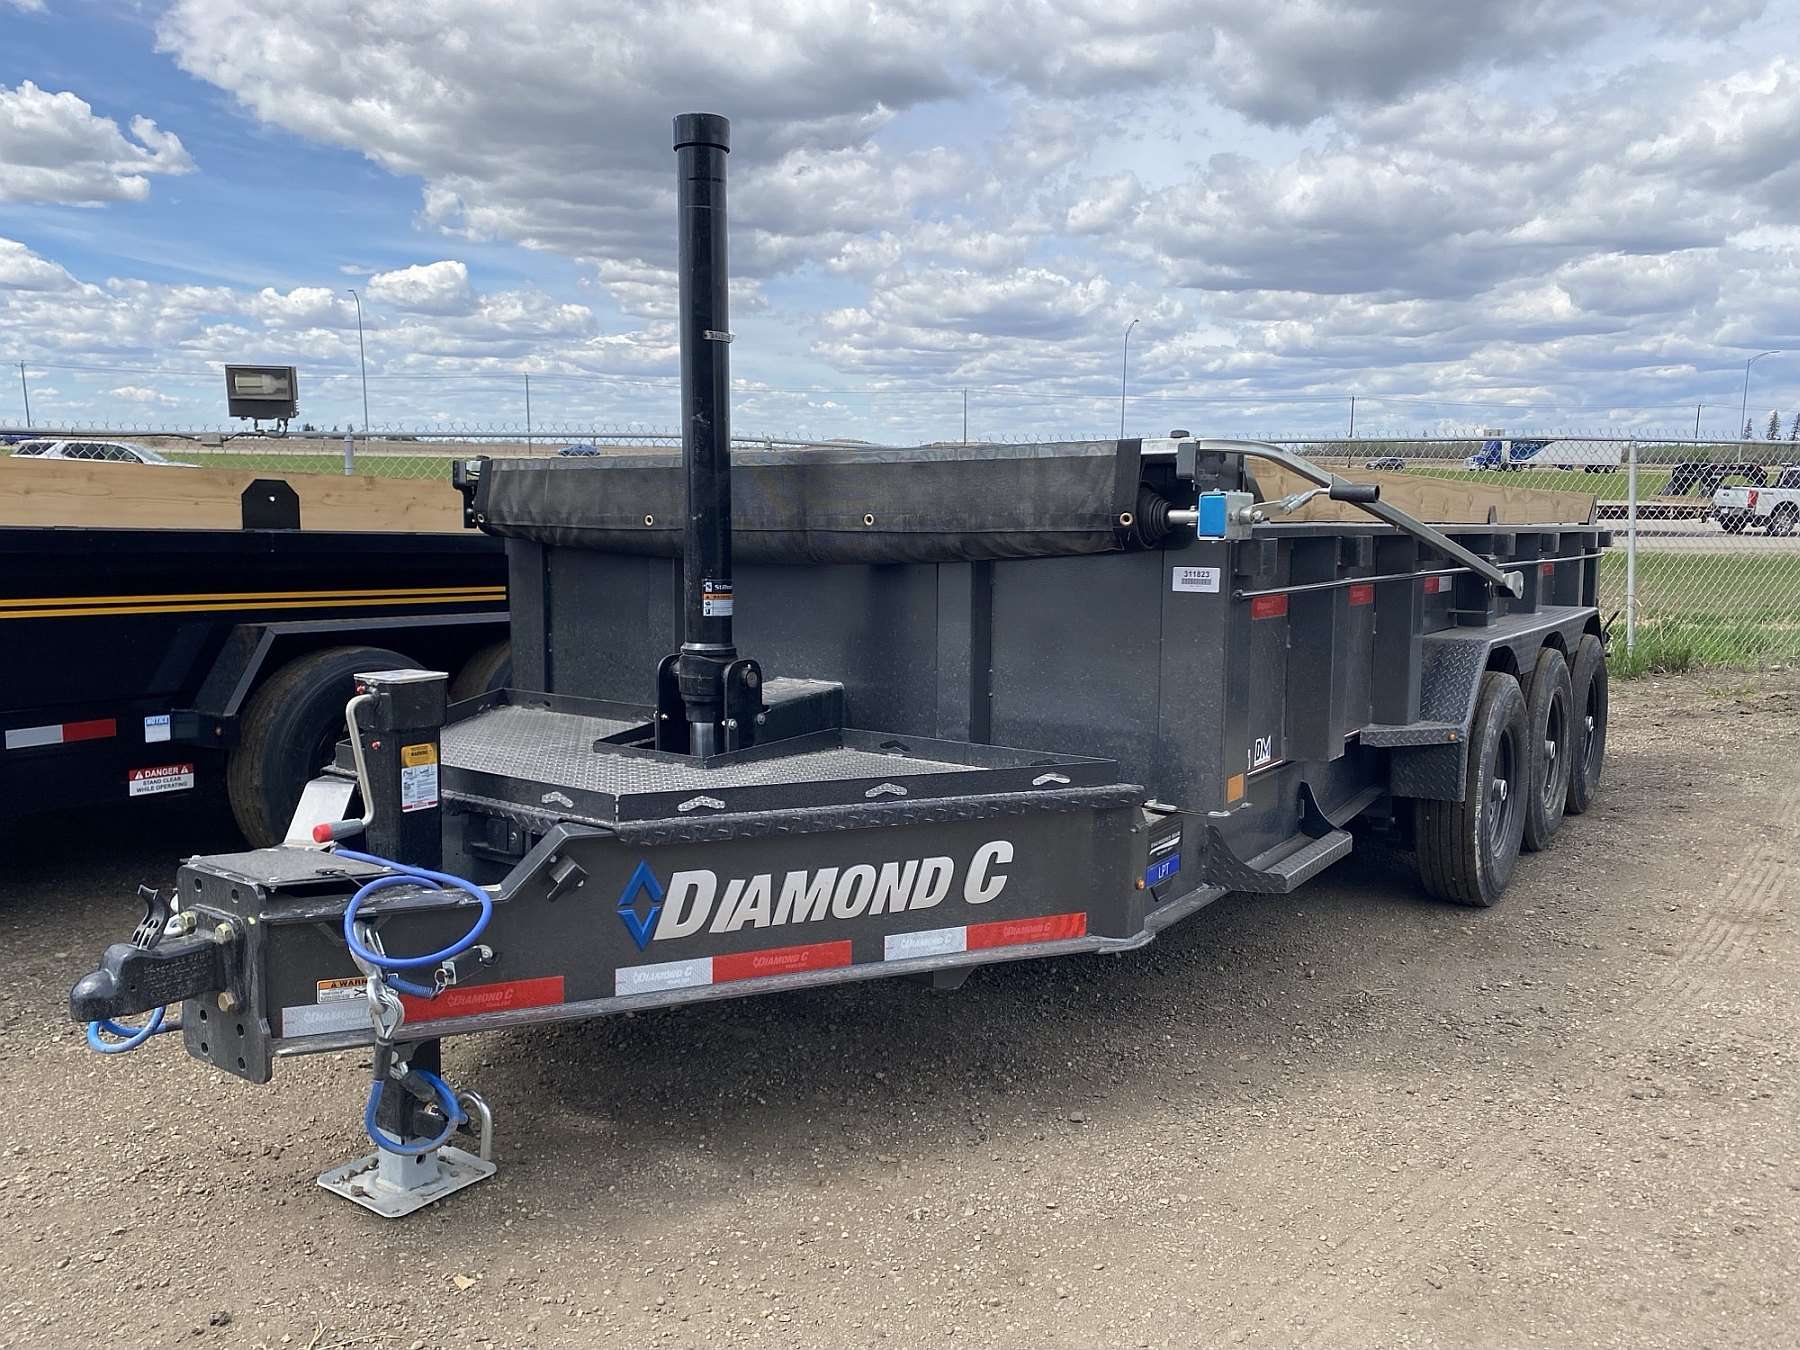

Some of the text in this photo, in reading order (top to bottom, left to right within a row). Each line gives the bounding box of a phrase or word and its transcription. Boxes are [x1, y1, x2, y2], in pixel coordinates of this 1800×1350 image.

[144, 767, 179, 778] DANGER
[163, 776, 182, 784] CLEAR
[136, 781, 188, 793] WHILE OPERATING
[653, 840, 1014, 941] DIAMOND C
[340, 978, 368, 987] WARN
